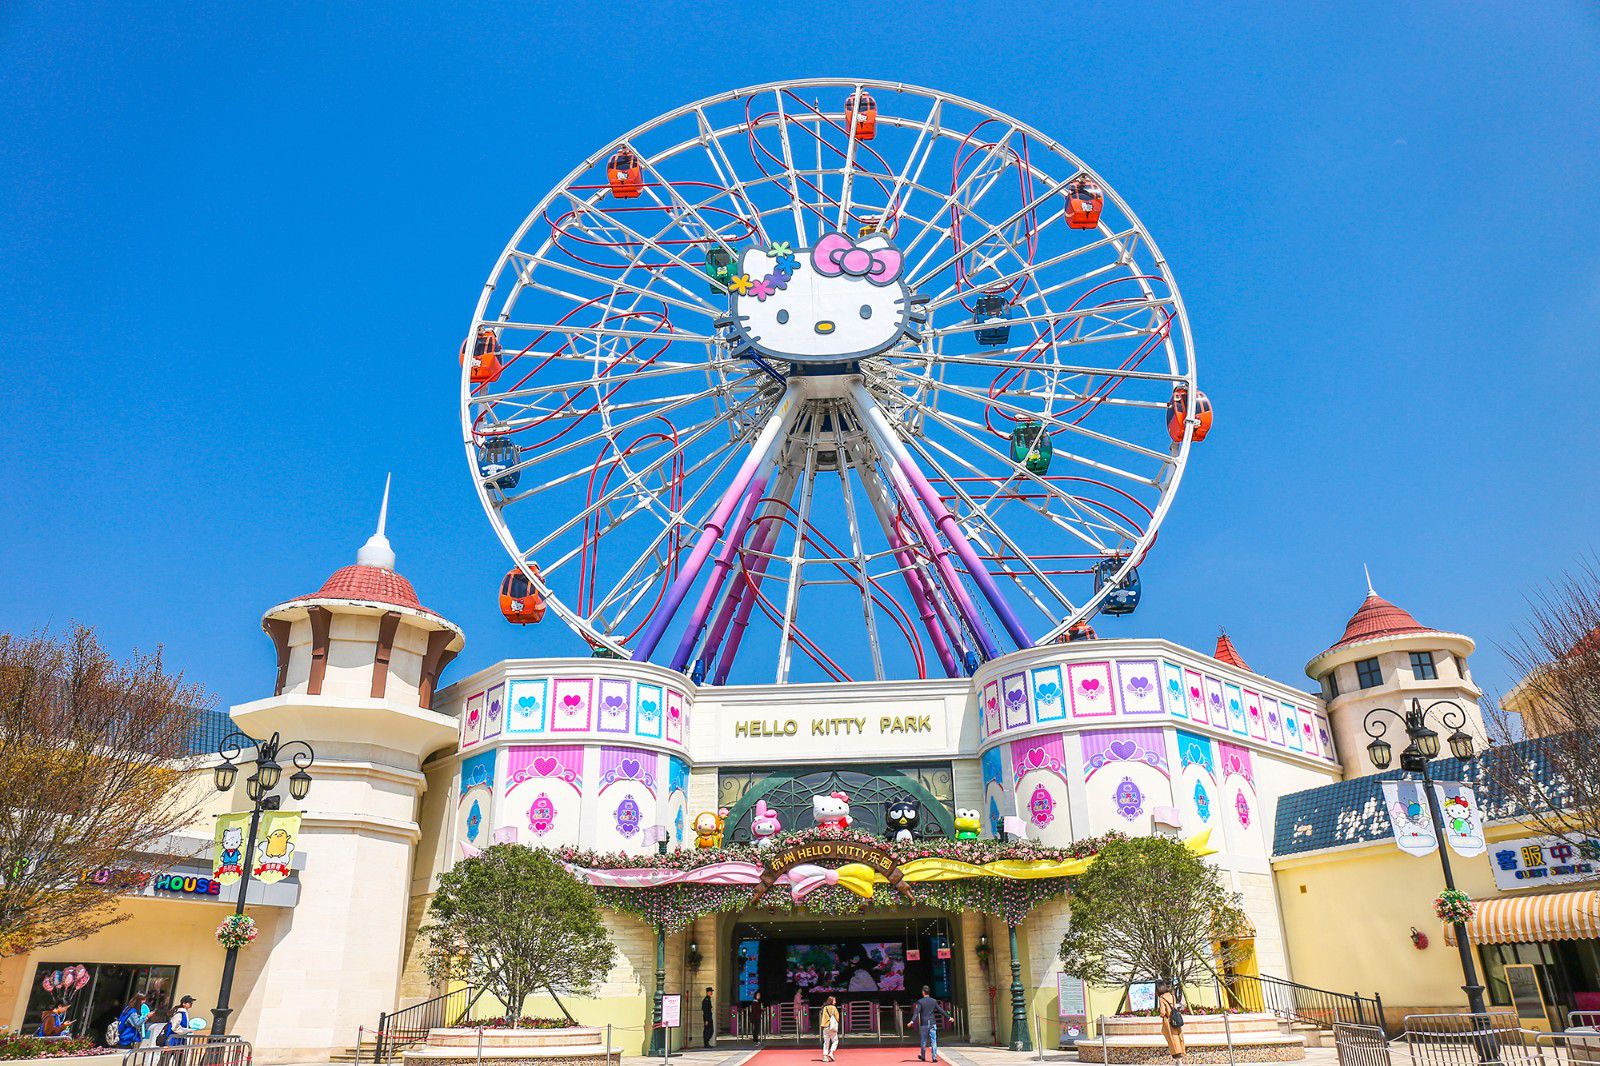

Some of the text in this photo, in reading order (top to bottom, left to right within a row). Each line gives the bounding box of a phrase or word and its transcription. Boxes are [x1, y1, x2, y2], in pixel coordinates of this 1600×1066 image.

[735, 715, 931, 738] HELLO KITTY PARK
[771, 844, 892, 870] 杭州 HELLO KITTY 乐园
[156, 874, 220, 895] HOUSE
[1515, 868, 1548, 879] GUEST
